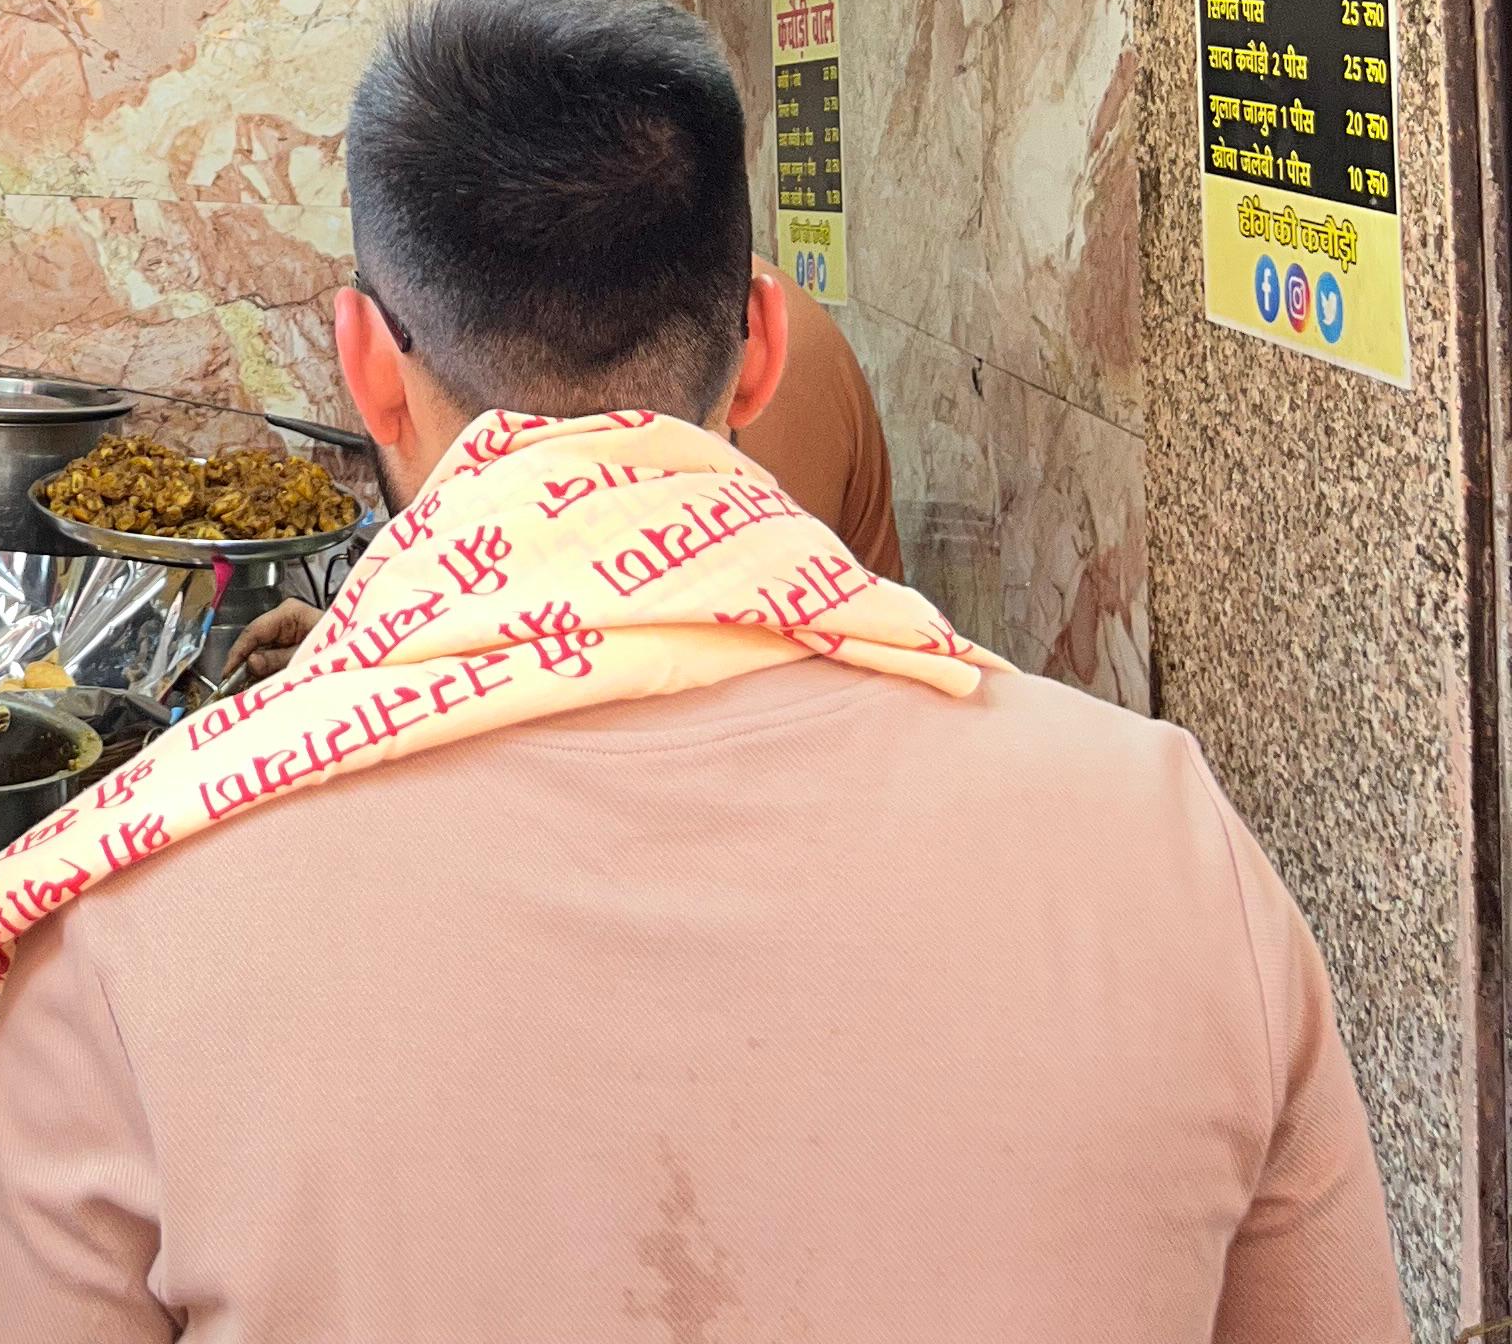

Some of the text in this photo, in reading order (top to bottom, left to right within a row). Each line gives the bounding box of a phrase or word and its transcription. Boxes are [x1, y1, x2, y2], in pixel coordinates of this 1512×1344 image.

[1341, 0, 1358, 25] 25
[1344, 54, 1361, 81] 25
[1273, 205, 1299, 251] की
